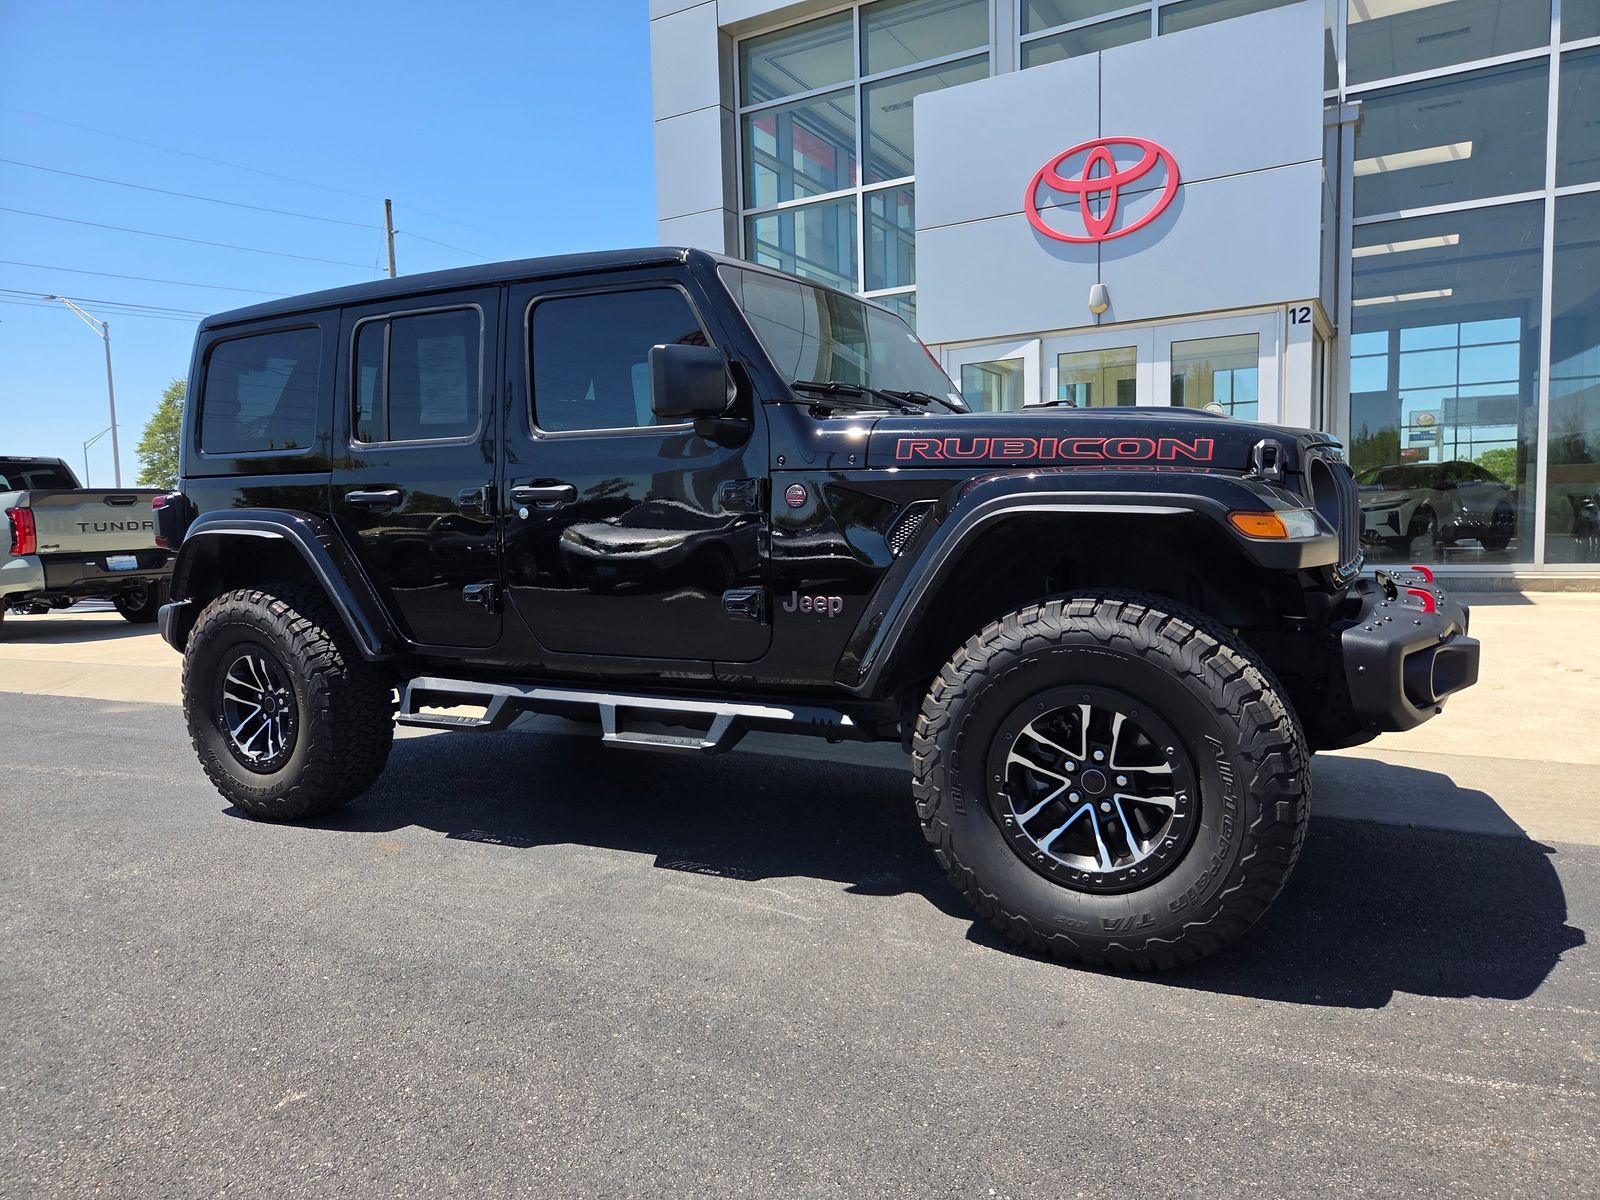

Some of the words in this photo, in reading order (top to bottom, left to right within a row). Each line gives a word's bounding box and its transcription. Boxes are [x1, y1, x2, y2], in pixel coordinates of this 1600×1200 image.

[1290, 307, 1311, 324] 12
[896, 438, 1214, 460] RUBICON
[76, 521, 154, 532] TUNDR
[782, 591, 843, 617] Jeep
[1101, 911, 1155, 931] T/A
